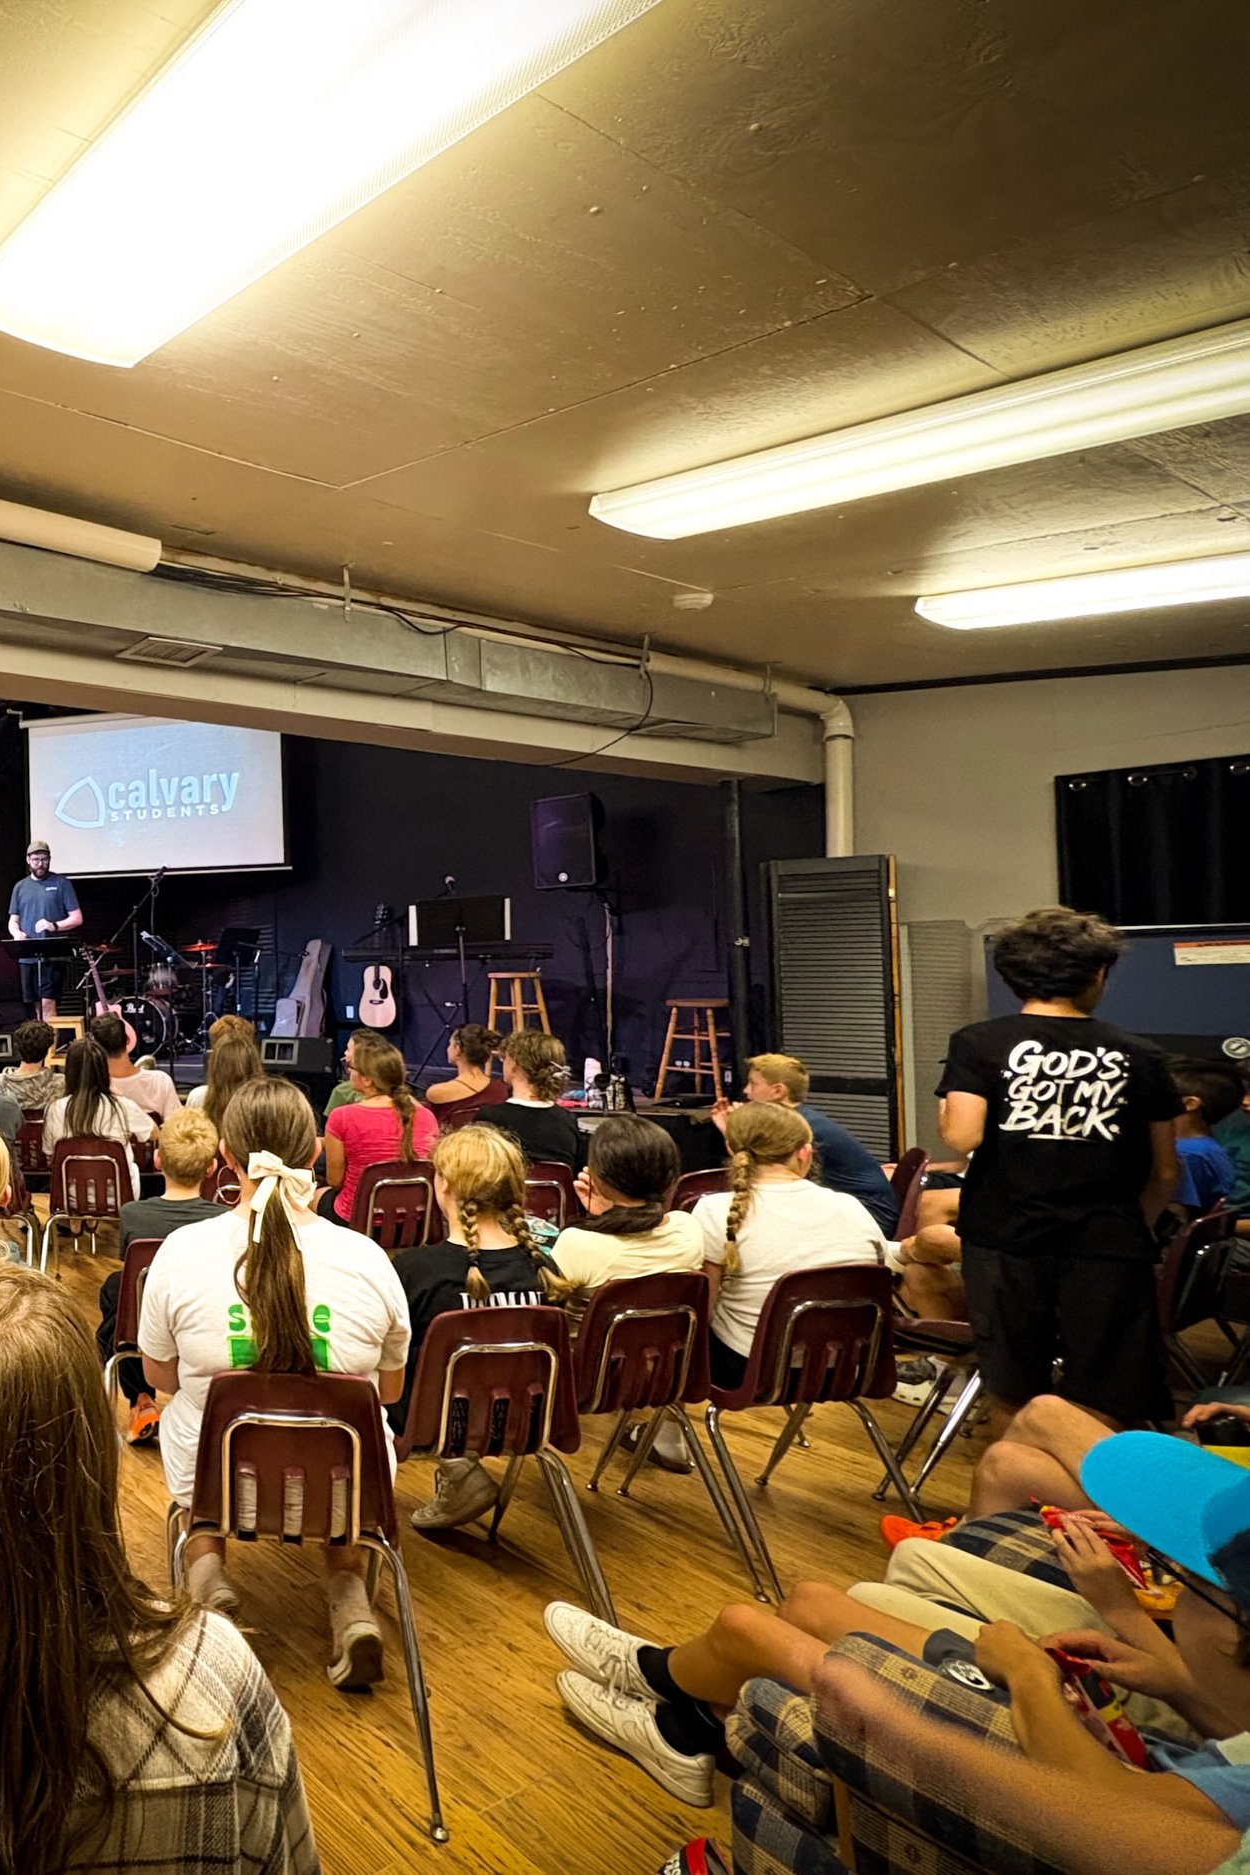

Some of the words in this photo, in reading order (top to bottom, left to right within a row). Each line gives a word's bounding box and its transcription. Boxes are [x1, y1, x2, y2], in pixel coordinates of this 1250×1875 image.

[108, 768, 240, 812] calvary
[110, 804, 219, 822] STUDENTS
[1008, 1040, 1125, 1080] GOD'S
[1008, 1075, 1075, 1105] GOT
[1073, 1079, 1128, 1108] MY
